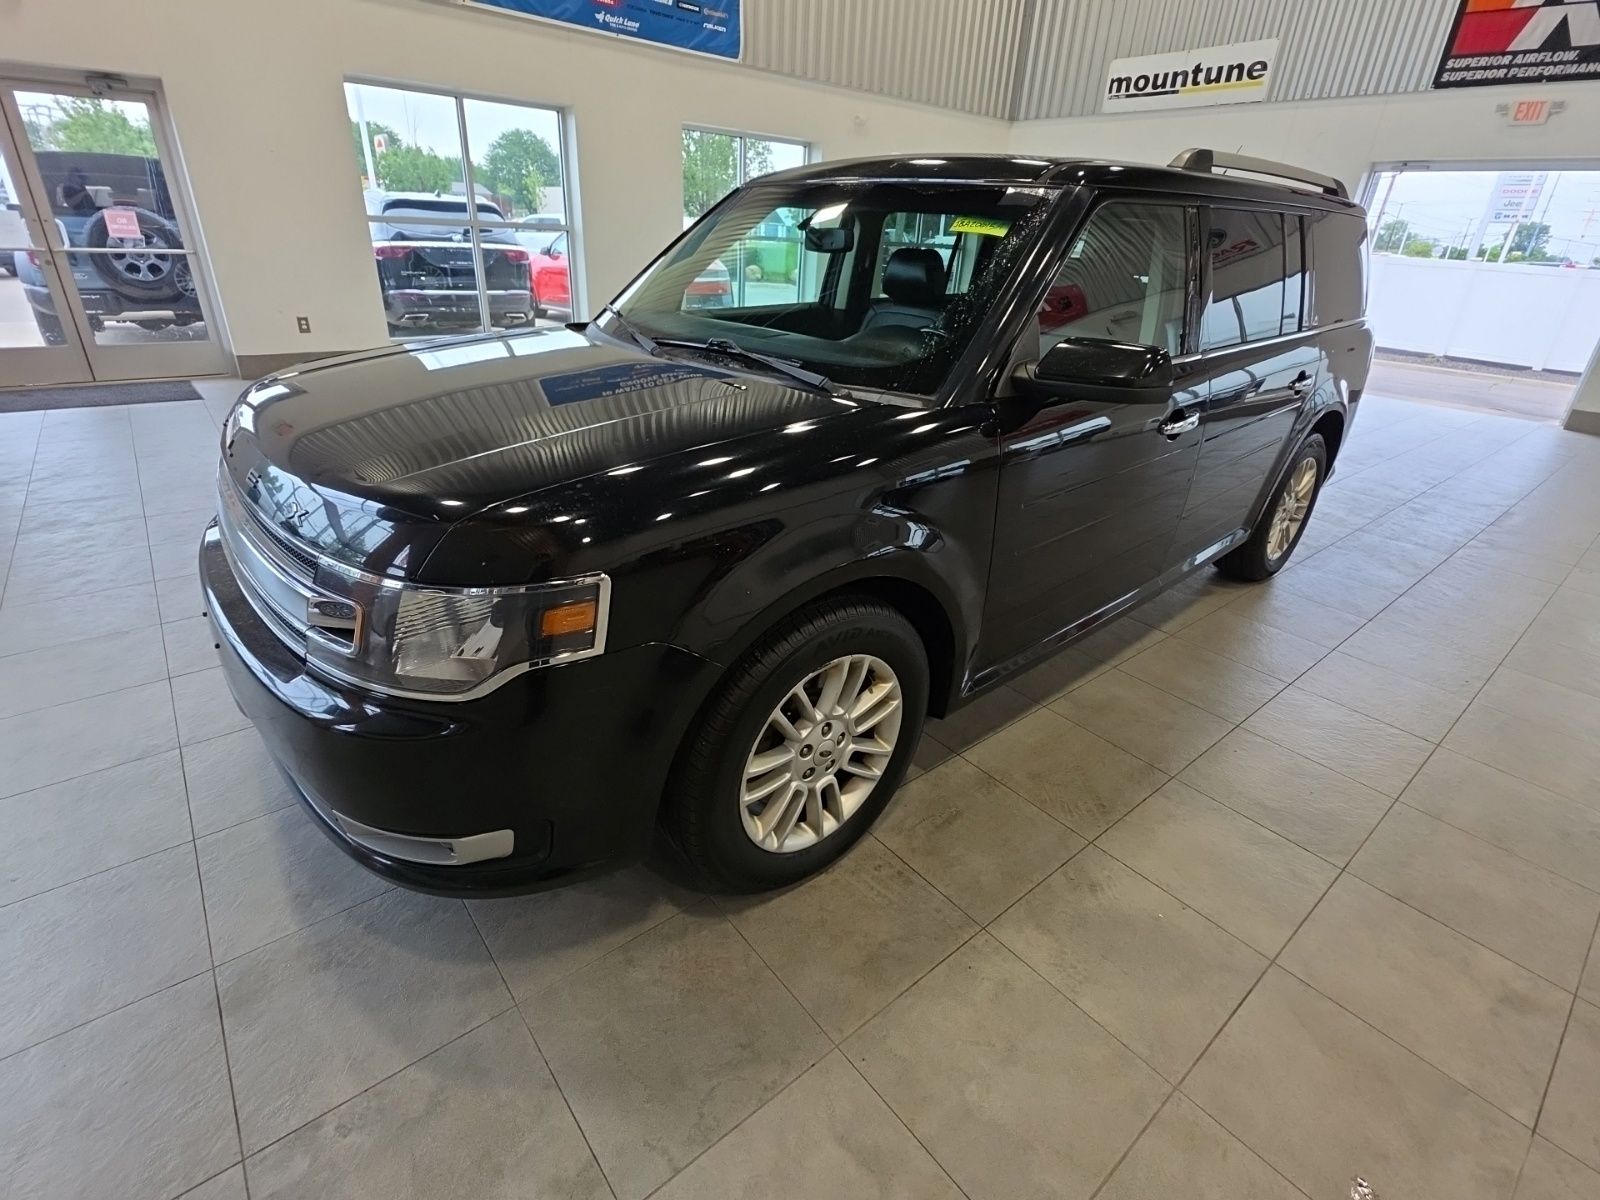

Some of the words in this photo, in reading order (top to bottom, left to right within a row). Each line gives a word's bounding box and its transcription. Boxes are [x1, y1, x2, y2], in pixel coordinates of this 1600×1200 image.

[604, 14, 624, 25] Quick
[624, 18, 641, 28] Lane
[1445, 54, 1514, 69] SUPERIOR
[1511, 50, 1581, 64] AIRFLOW.
[1108, 60, 1268, 95] mountune
[1440, 68, 1509, 82] SUPERIOR
[1513, 101, 1548, 121] EXIT
[1503, 199, 1524, 208] Jee
